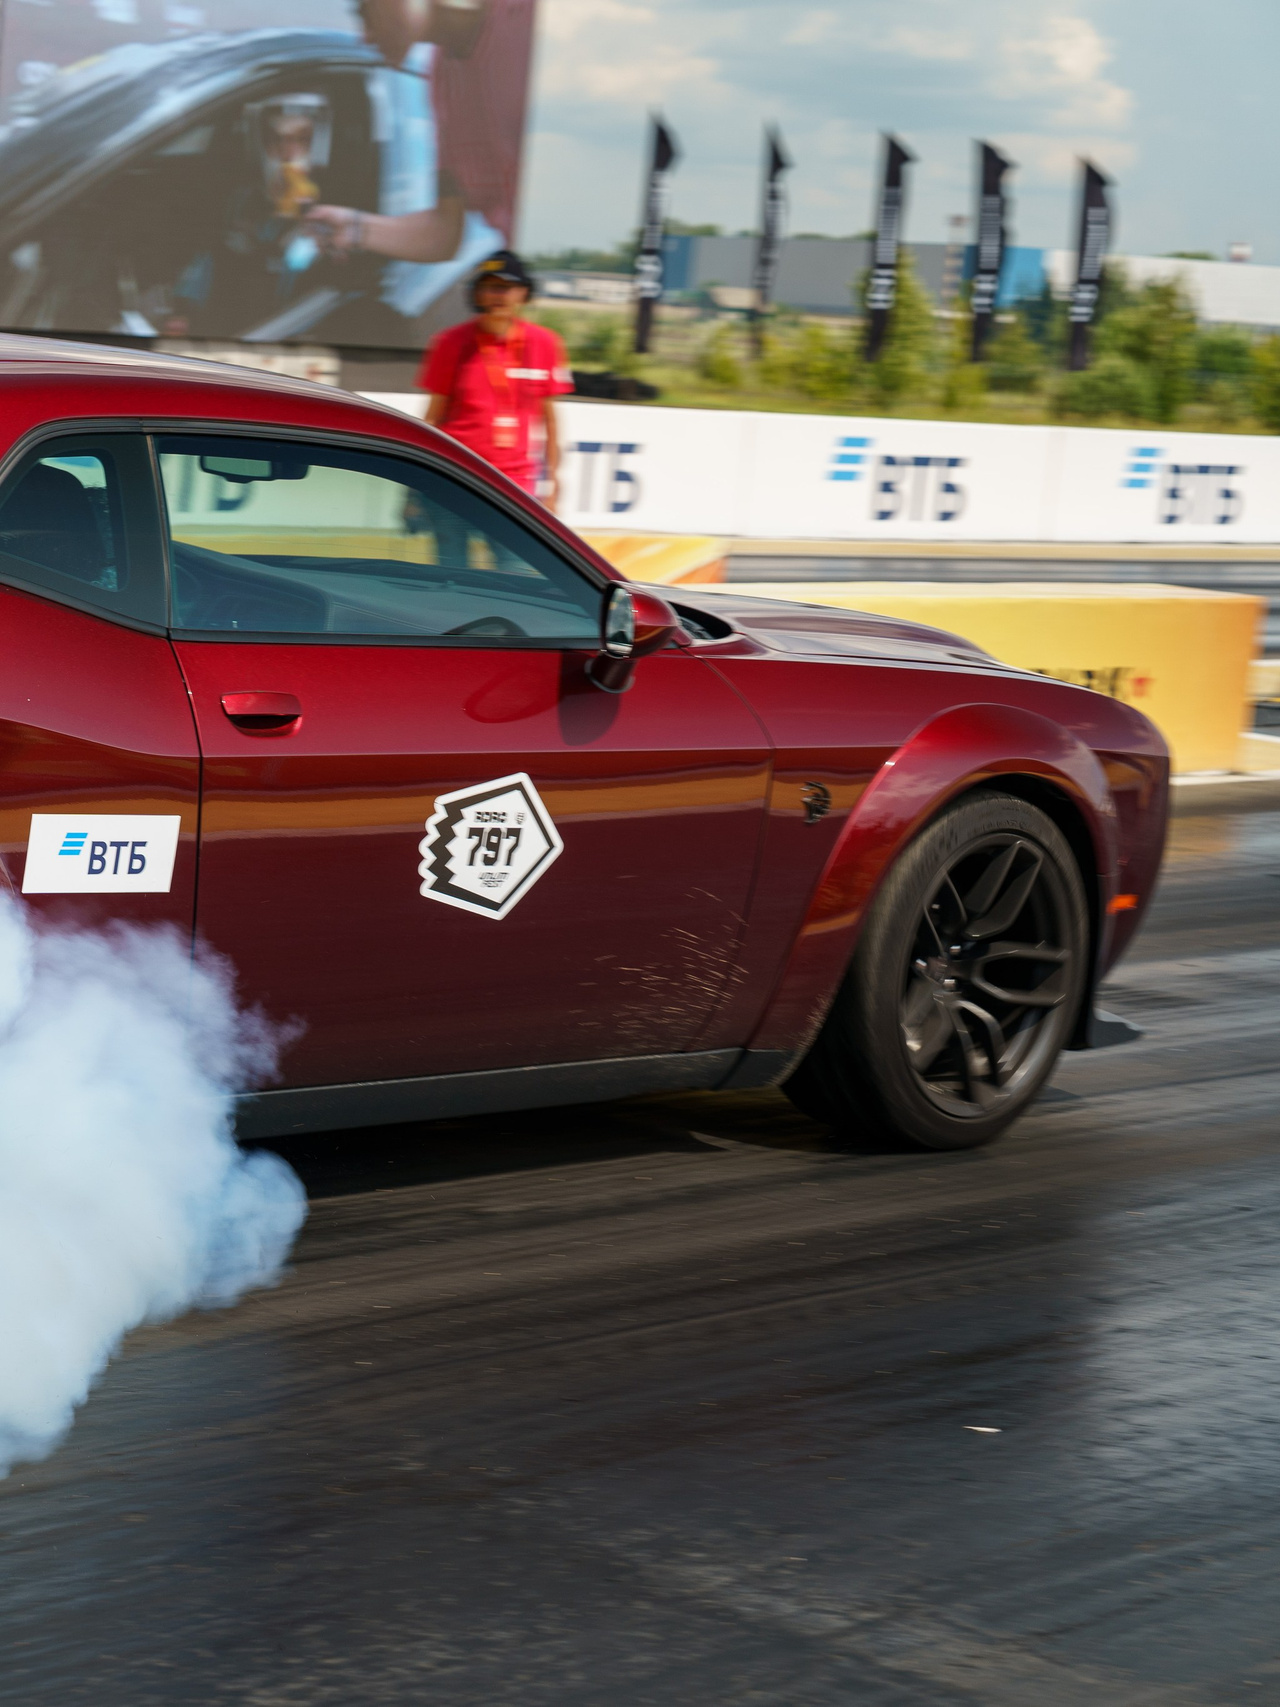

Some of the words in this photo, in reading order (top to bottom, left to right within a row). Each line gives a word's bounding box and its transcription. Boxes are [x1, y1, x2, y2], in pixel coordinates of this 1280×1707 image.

[870, 455, 969, 522] ВТБ
[1157, 465, 1246, 525] ВТБ
[87, 841, 148, 875] ВТБ
[466, 827, 523, 866] 797
